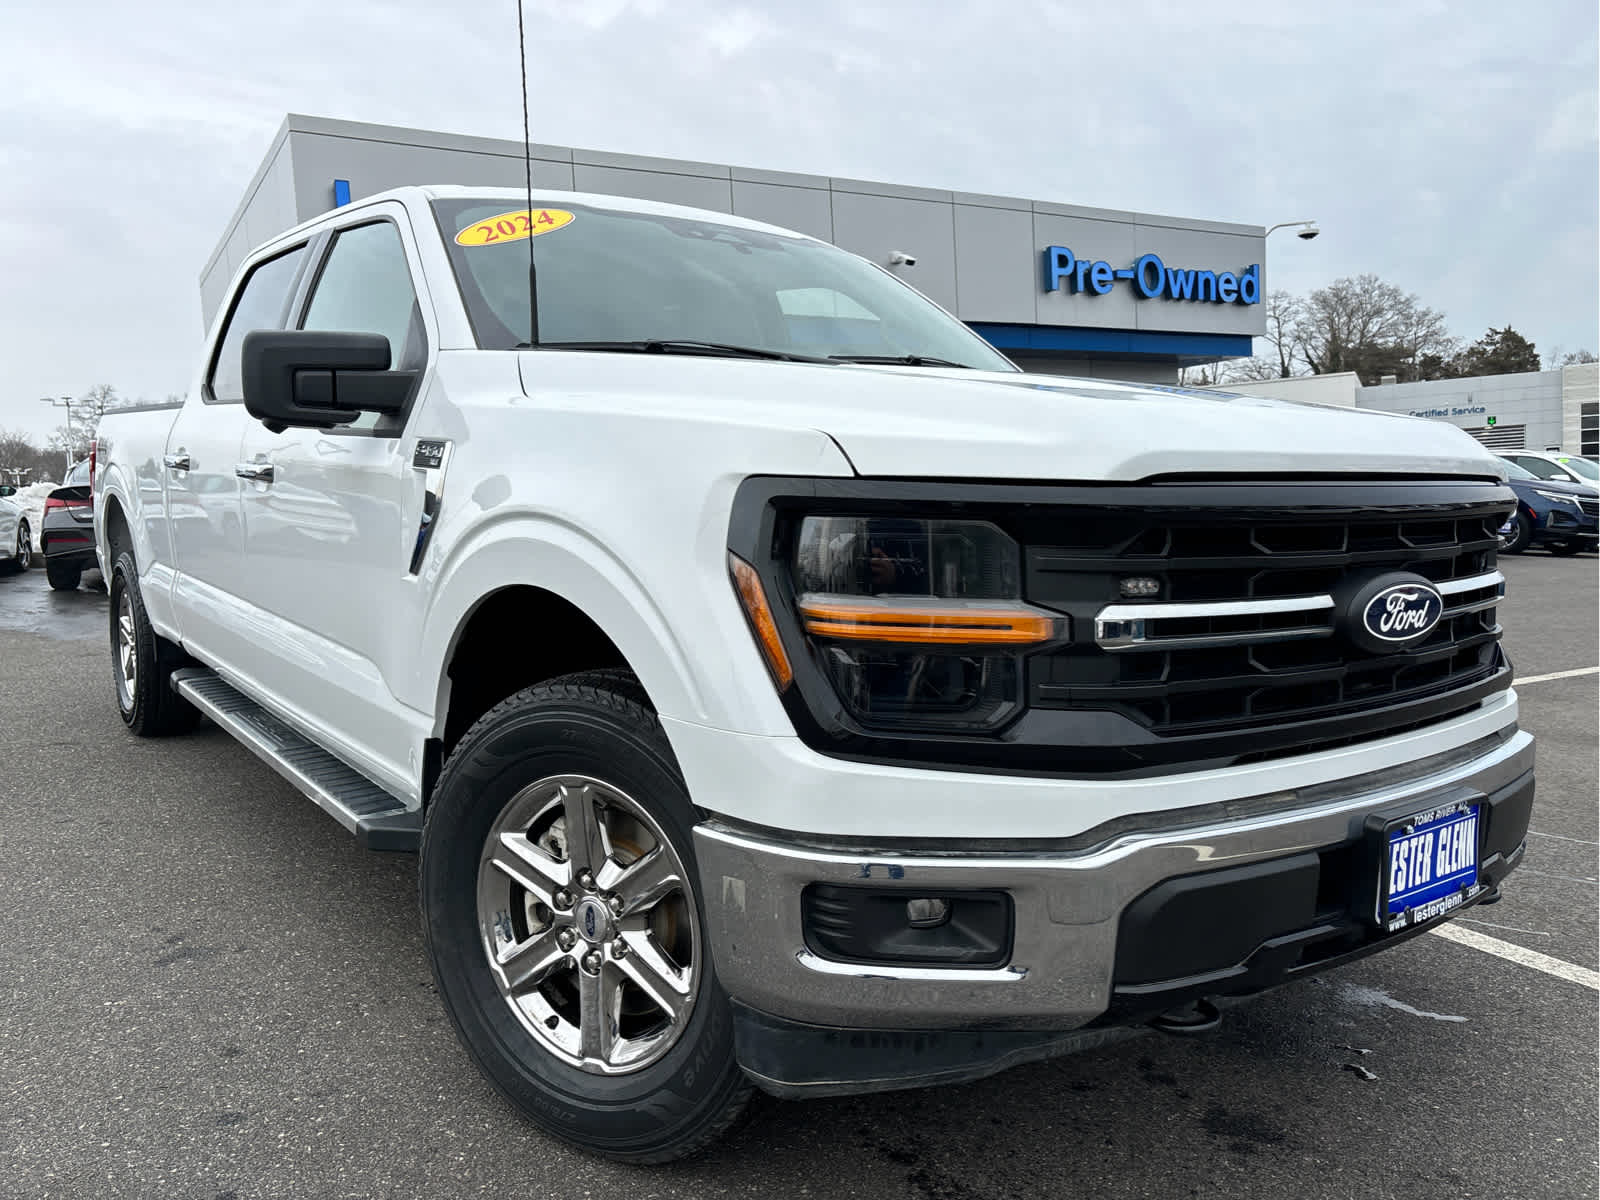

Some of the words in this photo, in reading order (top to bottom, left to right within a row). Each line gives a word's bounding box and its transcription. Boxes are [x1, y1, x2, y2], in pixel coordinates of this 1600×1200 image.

[477, 211, 555, 242] 2024
[1047, 246, 1260, 304] Pre-Owned
[1409, 408, 1449, 417] Certified
[1452, 406, 1486, 416] Service
[1380, 593, 1427, 632] Ford
[1414, 812, 1434, 827] TOMS
[1435, 804, 1457, 820] RIVER
[1389, 832, 1434, 895] ESTER
[1436, 818, 1476, 878] GLENN
[1414, 893, 1463, 924] lesterglenn
